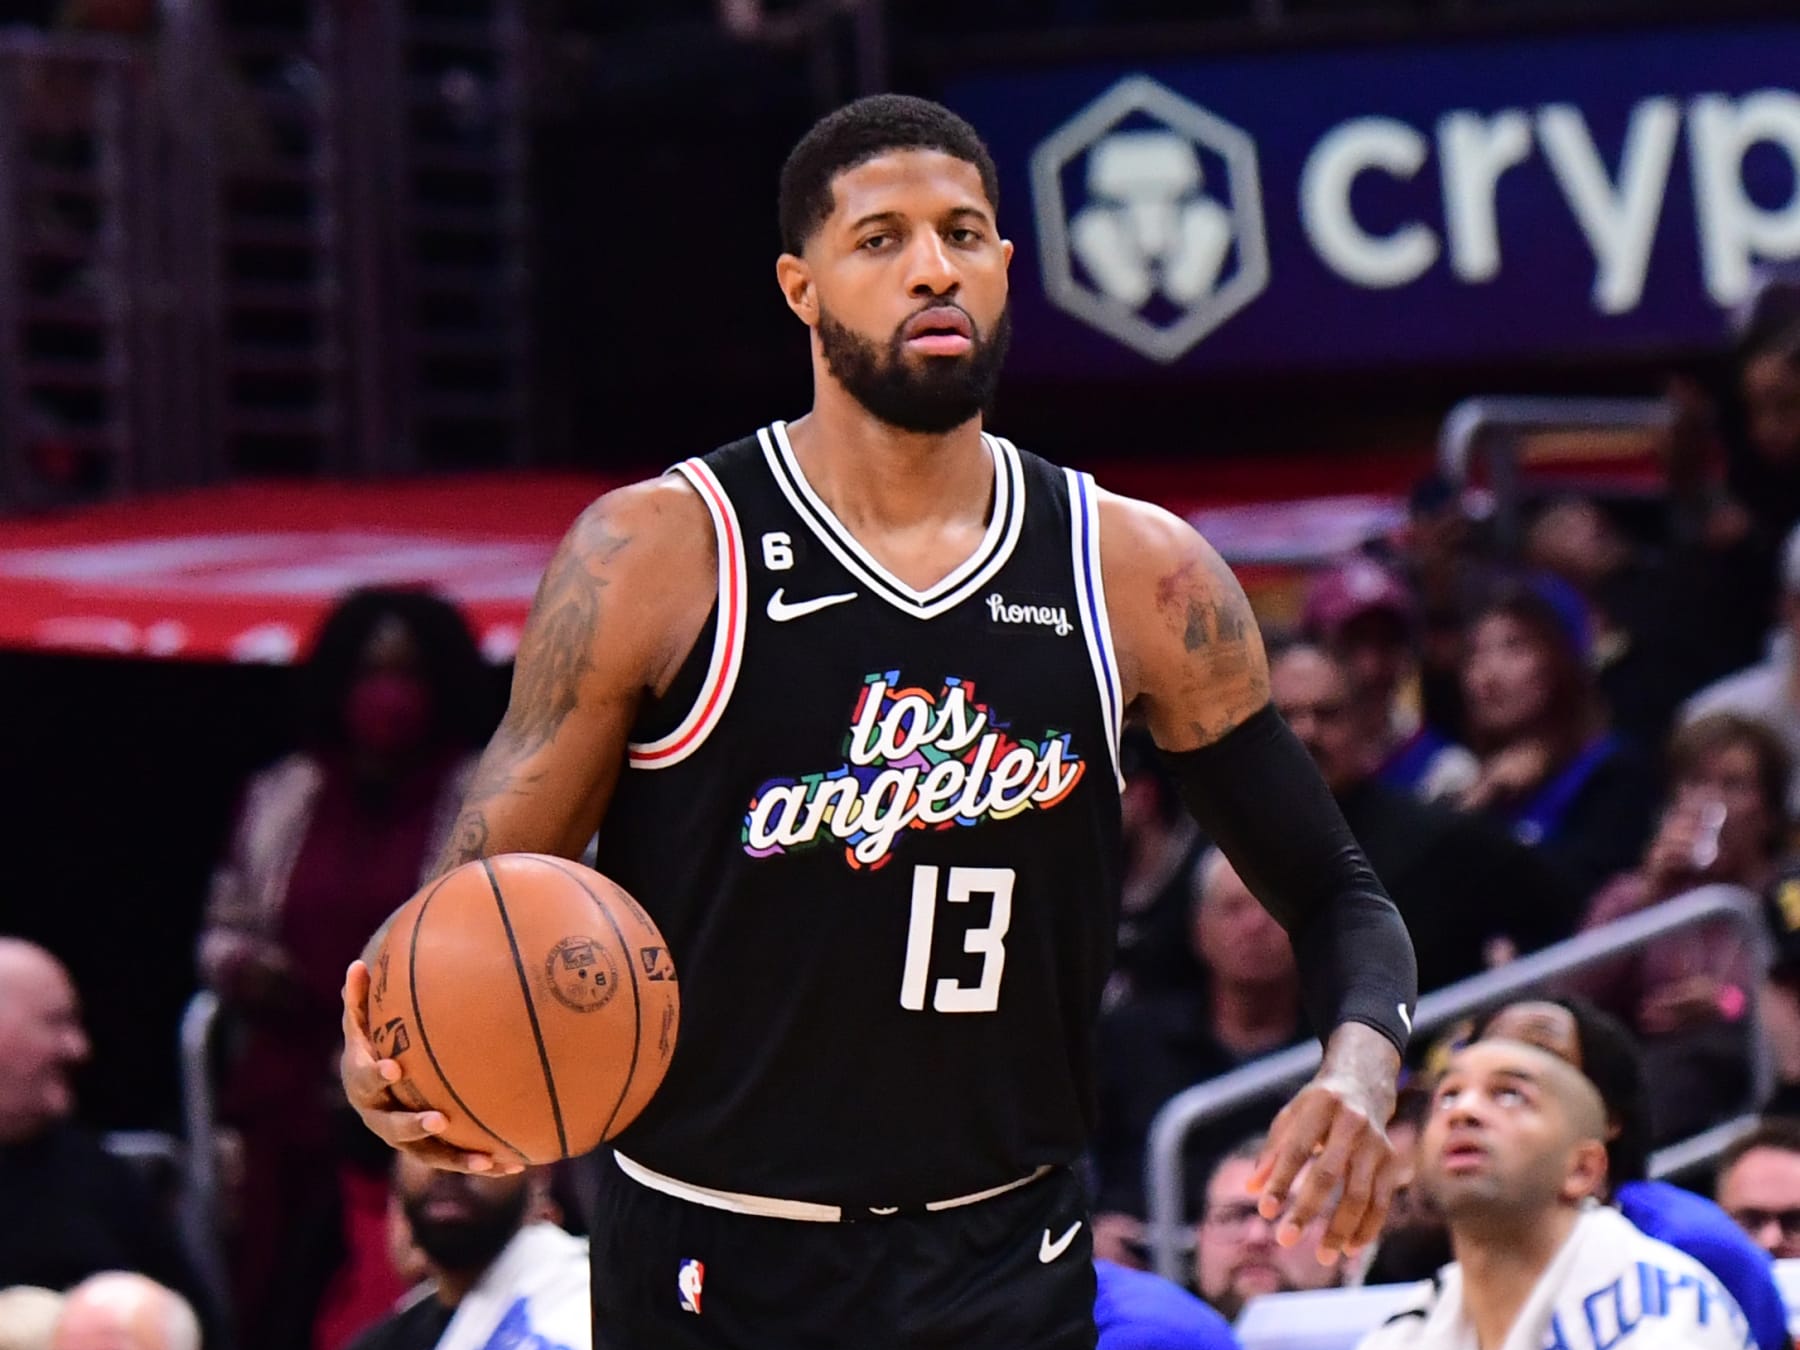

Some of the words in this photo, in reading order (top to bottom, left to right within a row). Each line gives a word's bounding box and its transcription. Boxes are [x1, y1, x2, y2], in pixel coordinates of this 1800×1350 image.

[1300, 87, 1800, 314] cryp
[761, 532, 794, 571] 6
[986, 593, 1073, 636] honey
[849, 679, 988, 766] los
[746, 734, 1079, 864] angeles
[900, 864, 1016, 1013] 13
